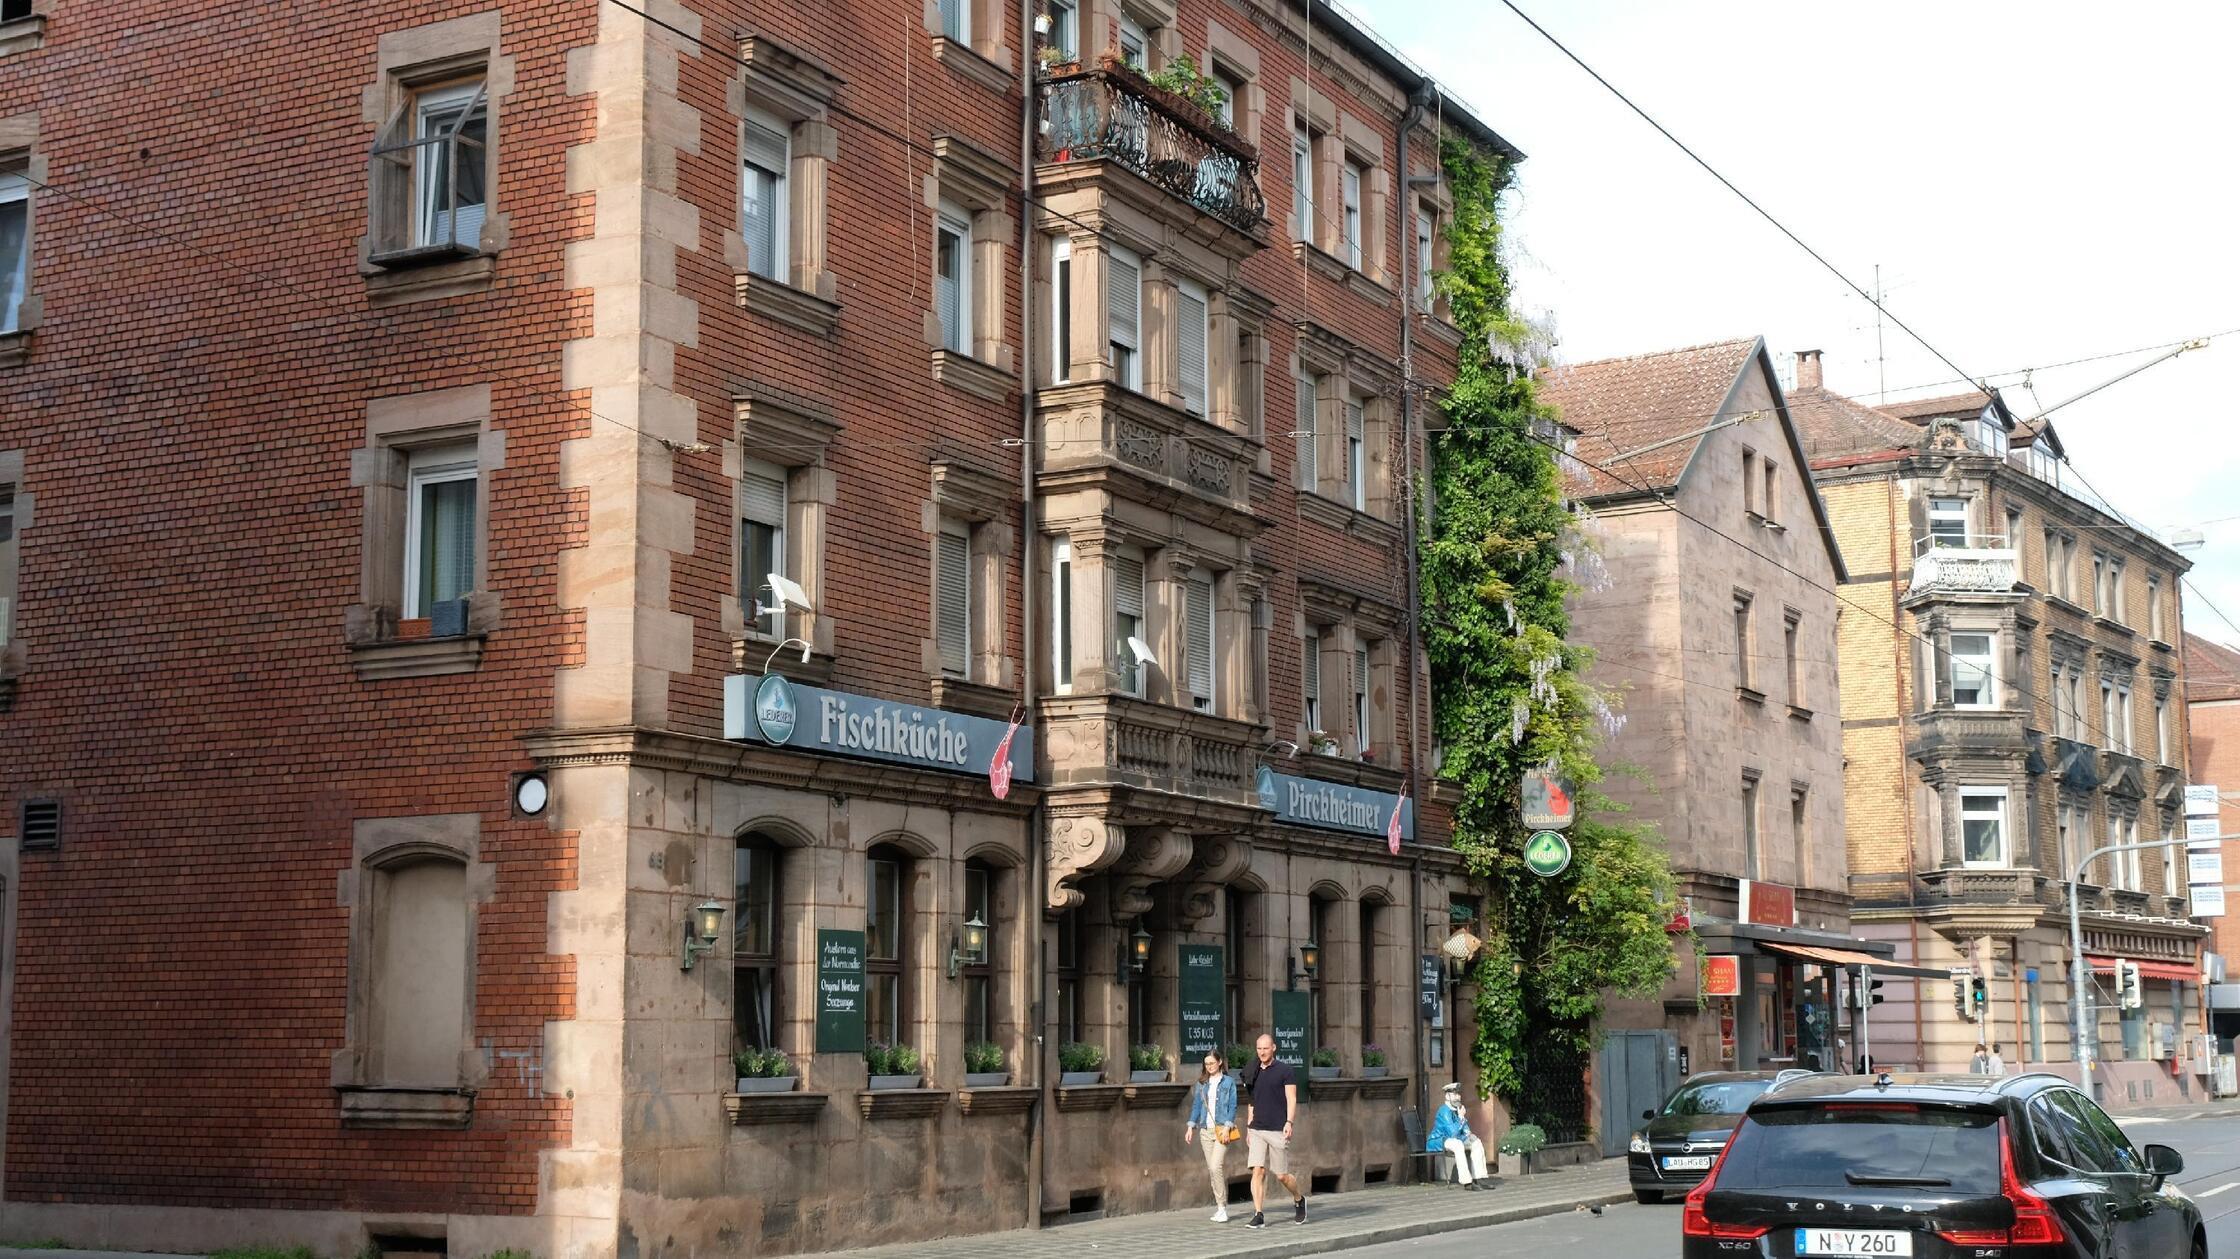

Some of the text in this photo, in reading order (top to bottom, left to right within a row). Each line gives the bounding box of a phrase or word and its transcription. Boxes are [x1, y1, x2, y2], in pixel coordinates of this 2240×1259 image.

[820, 696, 967, 764] Fischküche
[1288, 781, 1380, 830] Pirckheimer
[1525, 813, 1572, 825] Pirckheimer
[1786, 1202, 1913, 1213] VOLVO
[1819, 1232, 1896, 1253] N Y 260
